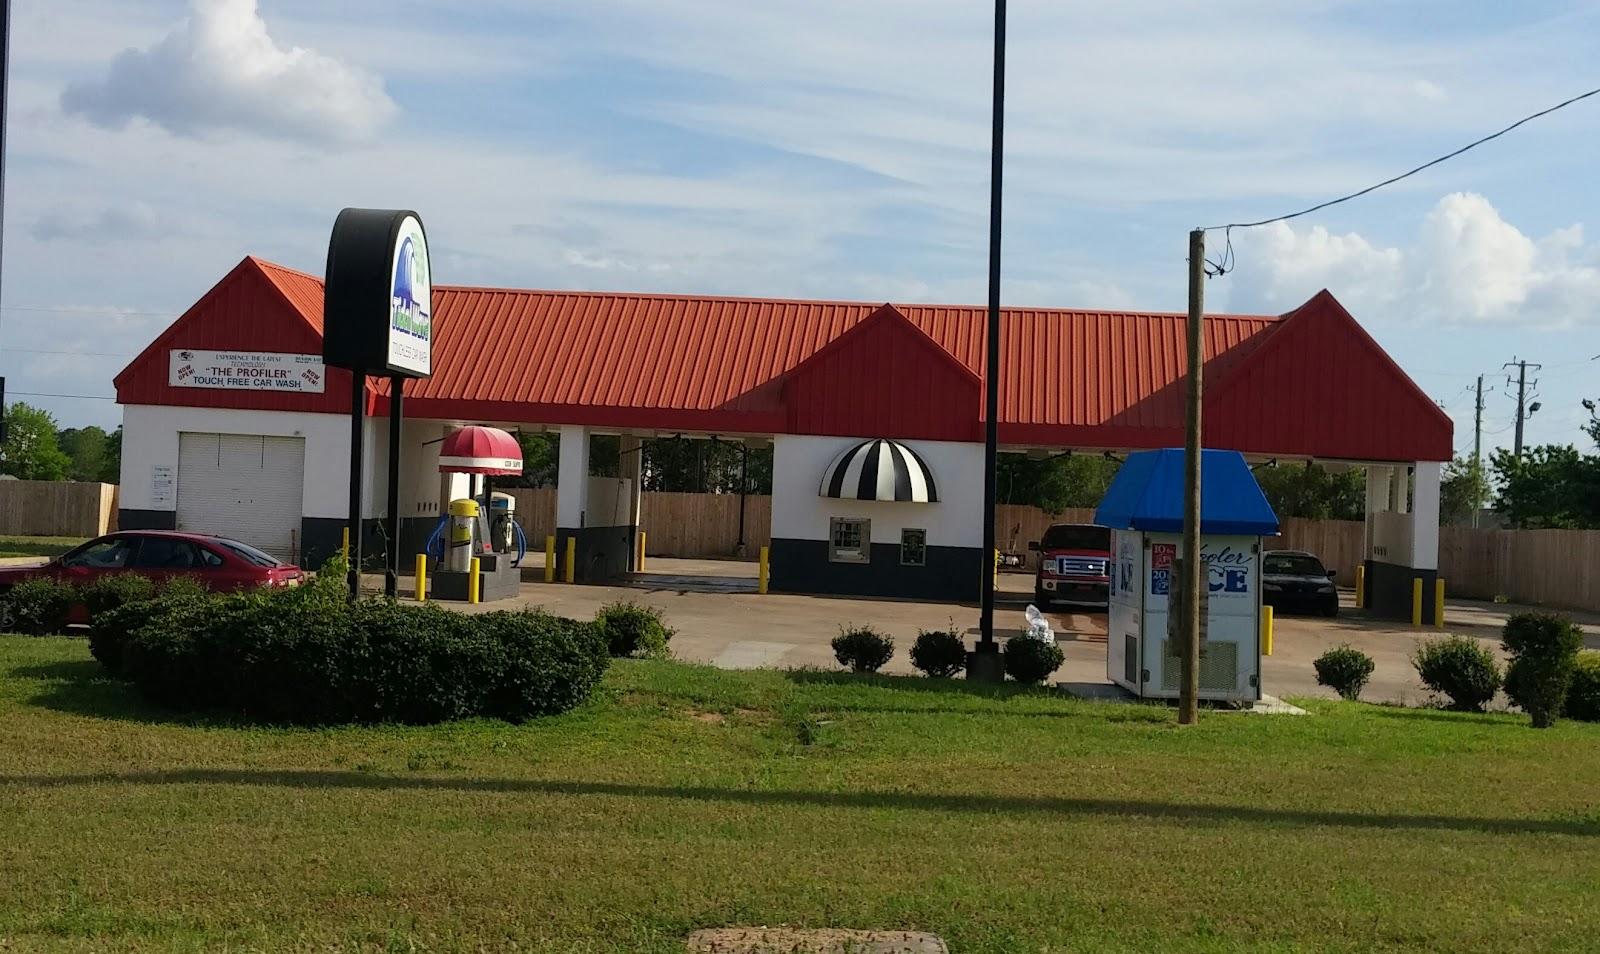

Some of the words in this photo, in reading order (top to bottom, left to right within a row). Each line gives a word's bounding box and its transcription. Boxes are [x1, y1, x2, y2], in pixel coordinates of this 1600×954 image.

[193, 375, 224, 385] TOUCH
[226, 377, 250, 387] FREE
[253, 378, 272, 387] CAR
[275, 379, 302, 388] WASH
[236, 367, 292, 379] PROFILER"
[1199, 544, 1253, 565] ooler
[1209, 564, 1249, 593] CE
